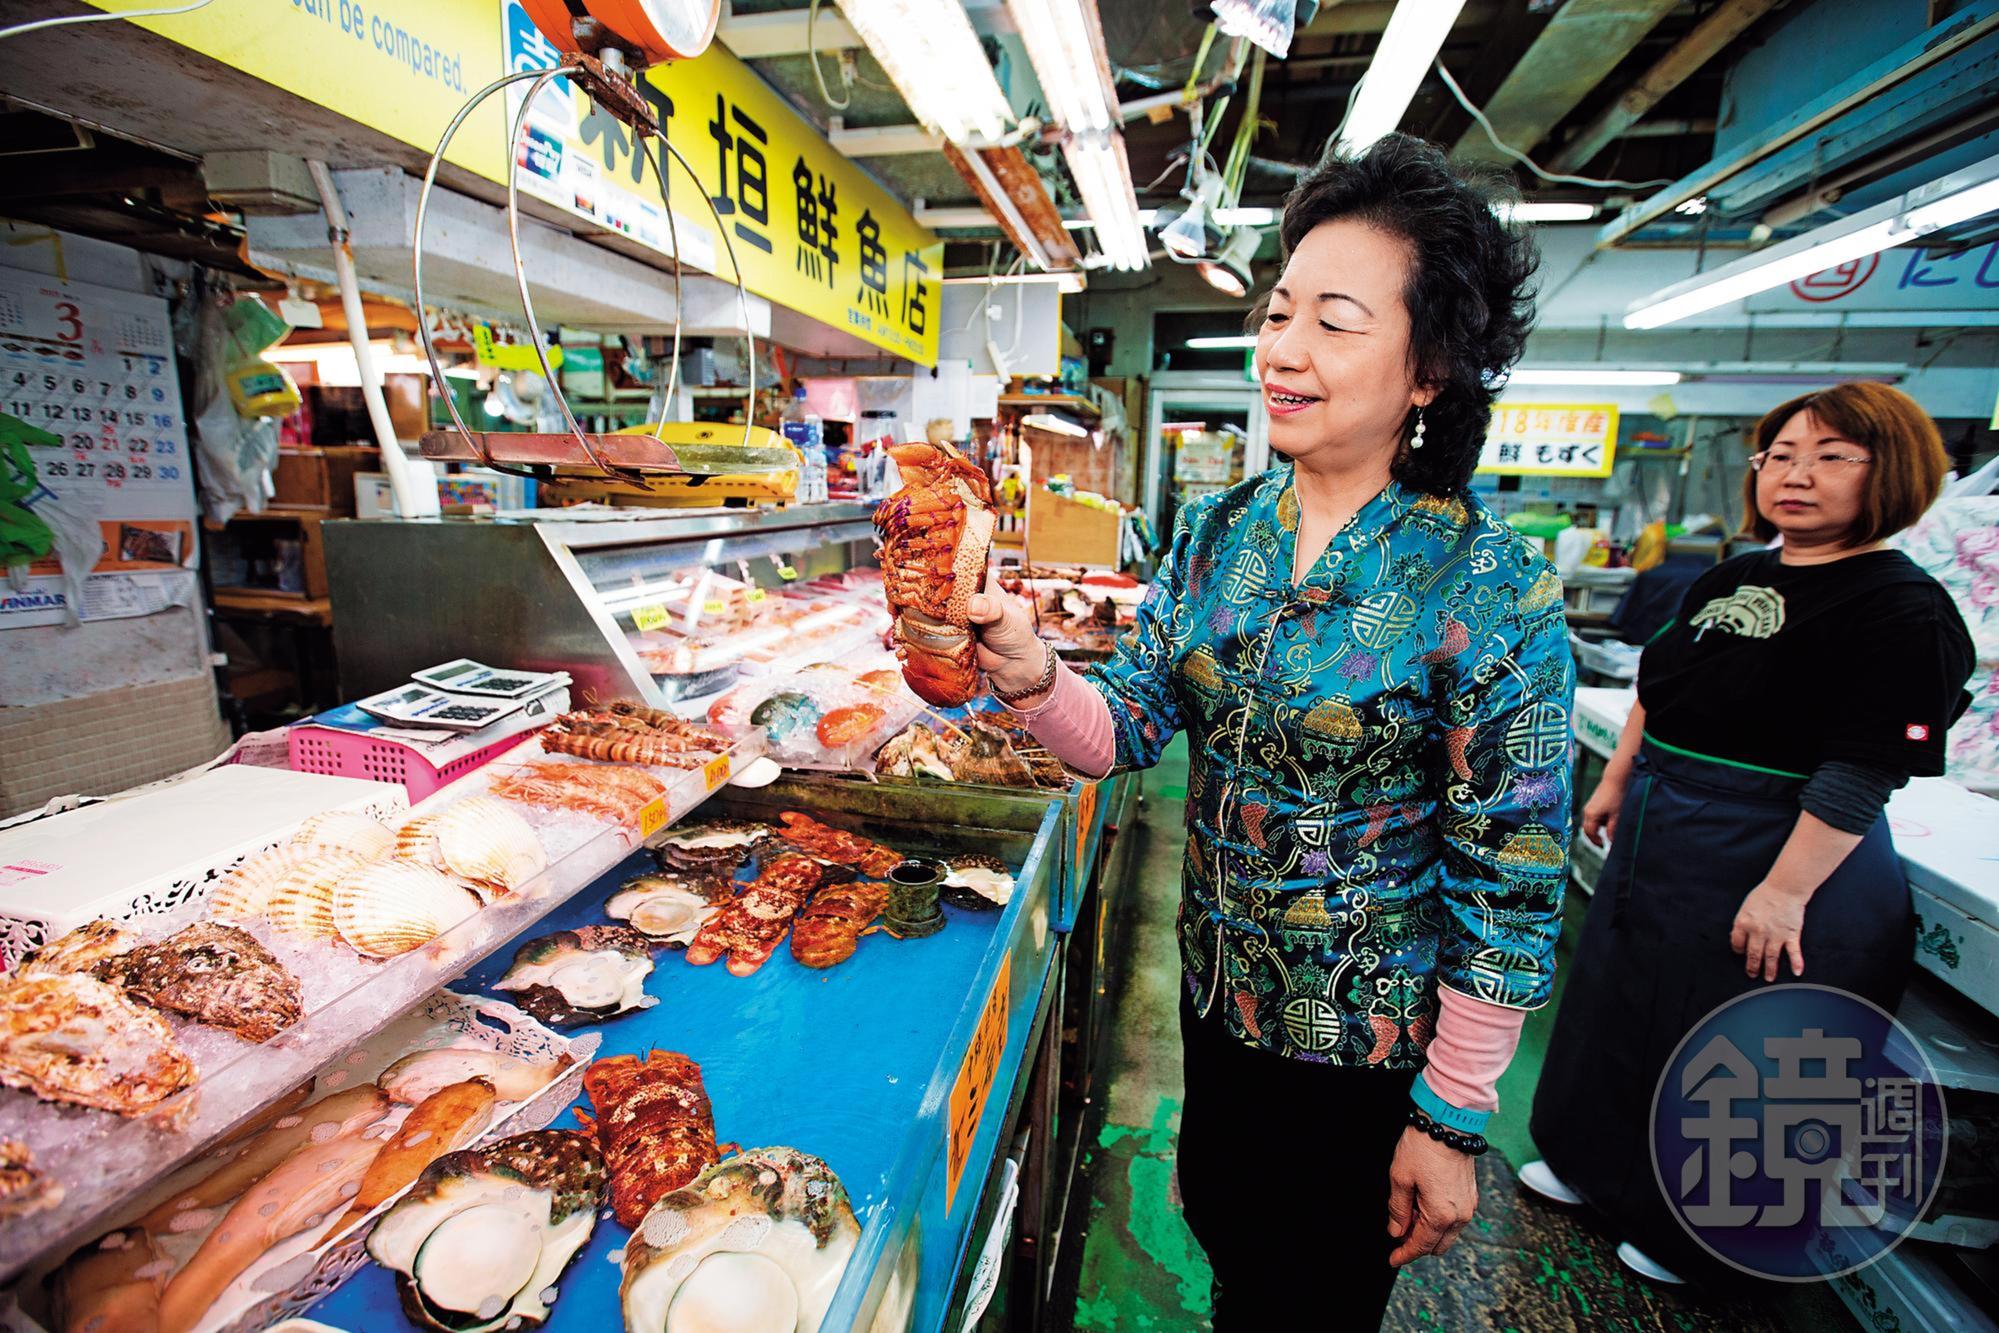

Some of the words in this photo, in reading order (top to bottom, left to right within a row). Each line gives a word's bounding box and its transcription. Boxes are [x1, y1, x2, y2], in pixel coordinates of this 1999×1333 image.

[340, 0, 364, 40] be
[371, 15, 467, 96] compared.
[55, 301, 84, 341] 3
[123, 358, 132, 372] 1
[149, 361, 161, 375] 2
[13, 372, 26, 387] 4
[43, 375, 57, 391] 5
[72, 379, 85, 394] 6
[100, 382, 111, 396] 7
[125, 385, 137, 399] 8
[152, 388, 164, 401] 9
[10, 401, 31, 416] 11
[43, 404, 64, 420] 12
[72, 407, 92, 422] 13
[100, 408, 119, 424] 14
[126, 411, 145, 426] 15
[153, 415, 173, 428] 16
[71, 434, 94, 450] 20
[101, 437, 120, 451] 21
[129, 438, 148, 453] 22
[155, 440, 175, 454] 23
[48, 461, 69, 476] 26
[76, 463, 96, 478] 27
[104, 463, 126, 479] 28
[133, 466, 152, 479] 29
[159, 467, 180, 480] 30
